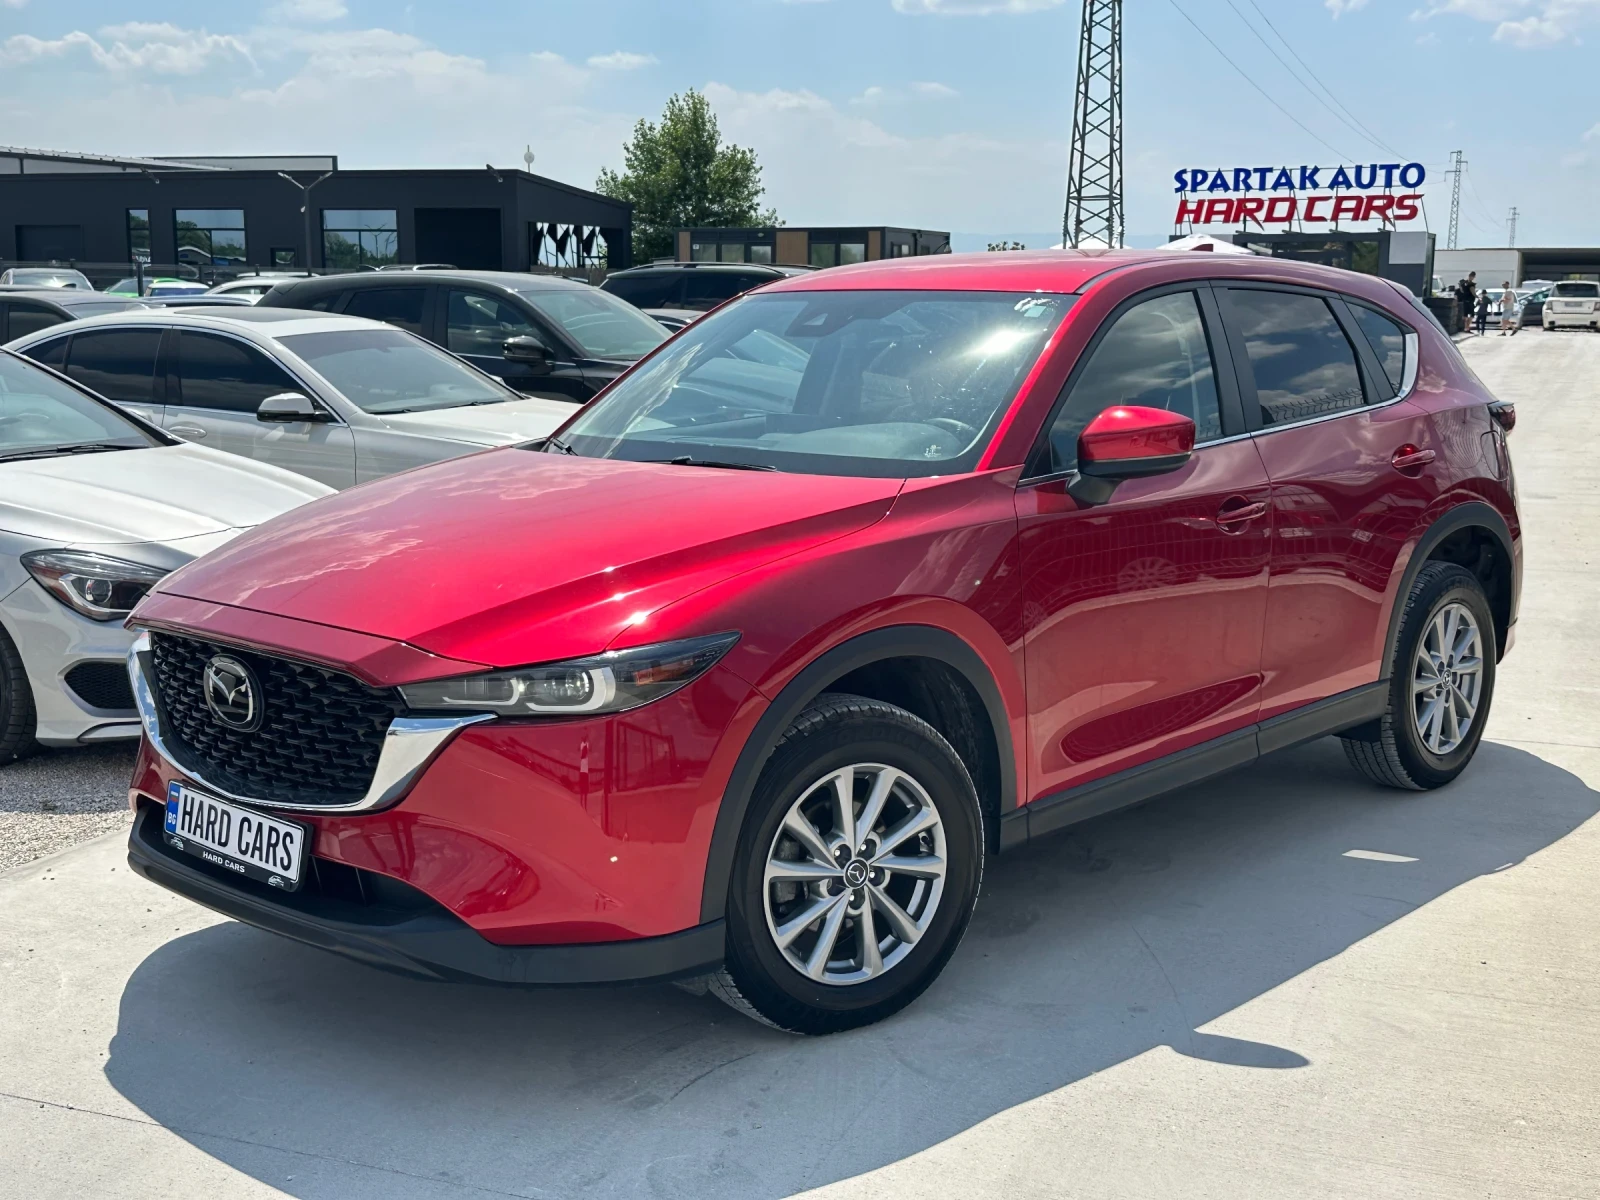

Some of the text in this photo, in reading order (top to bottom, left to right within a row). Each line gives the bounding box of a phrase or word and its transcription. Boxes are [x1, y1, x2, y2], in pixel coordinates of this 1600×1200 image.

[1174, 163, 1425, 193] SPARTAK AUTO
[1175, 194, 1424, 231] HARD CARS
[167, 812, 177, 825] BG
[181, 794, 294, 871] HARD CARS
[202, 851, 245, 873] HARD CARS
